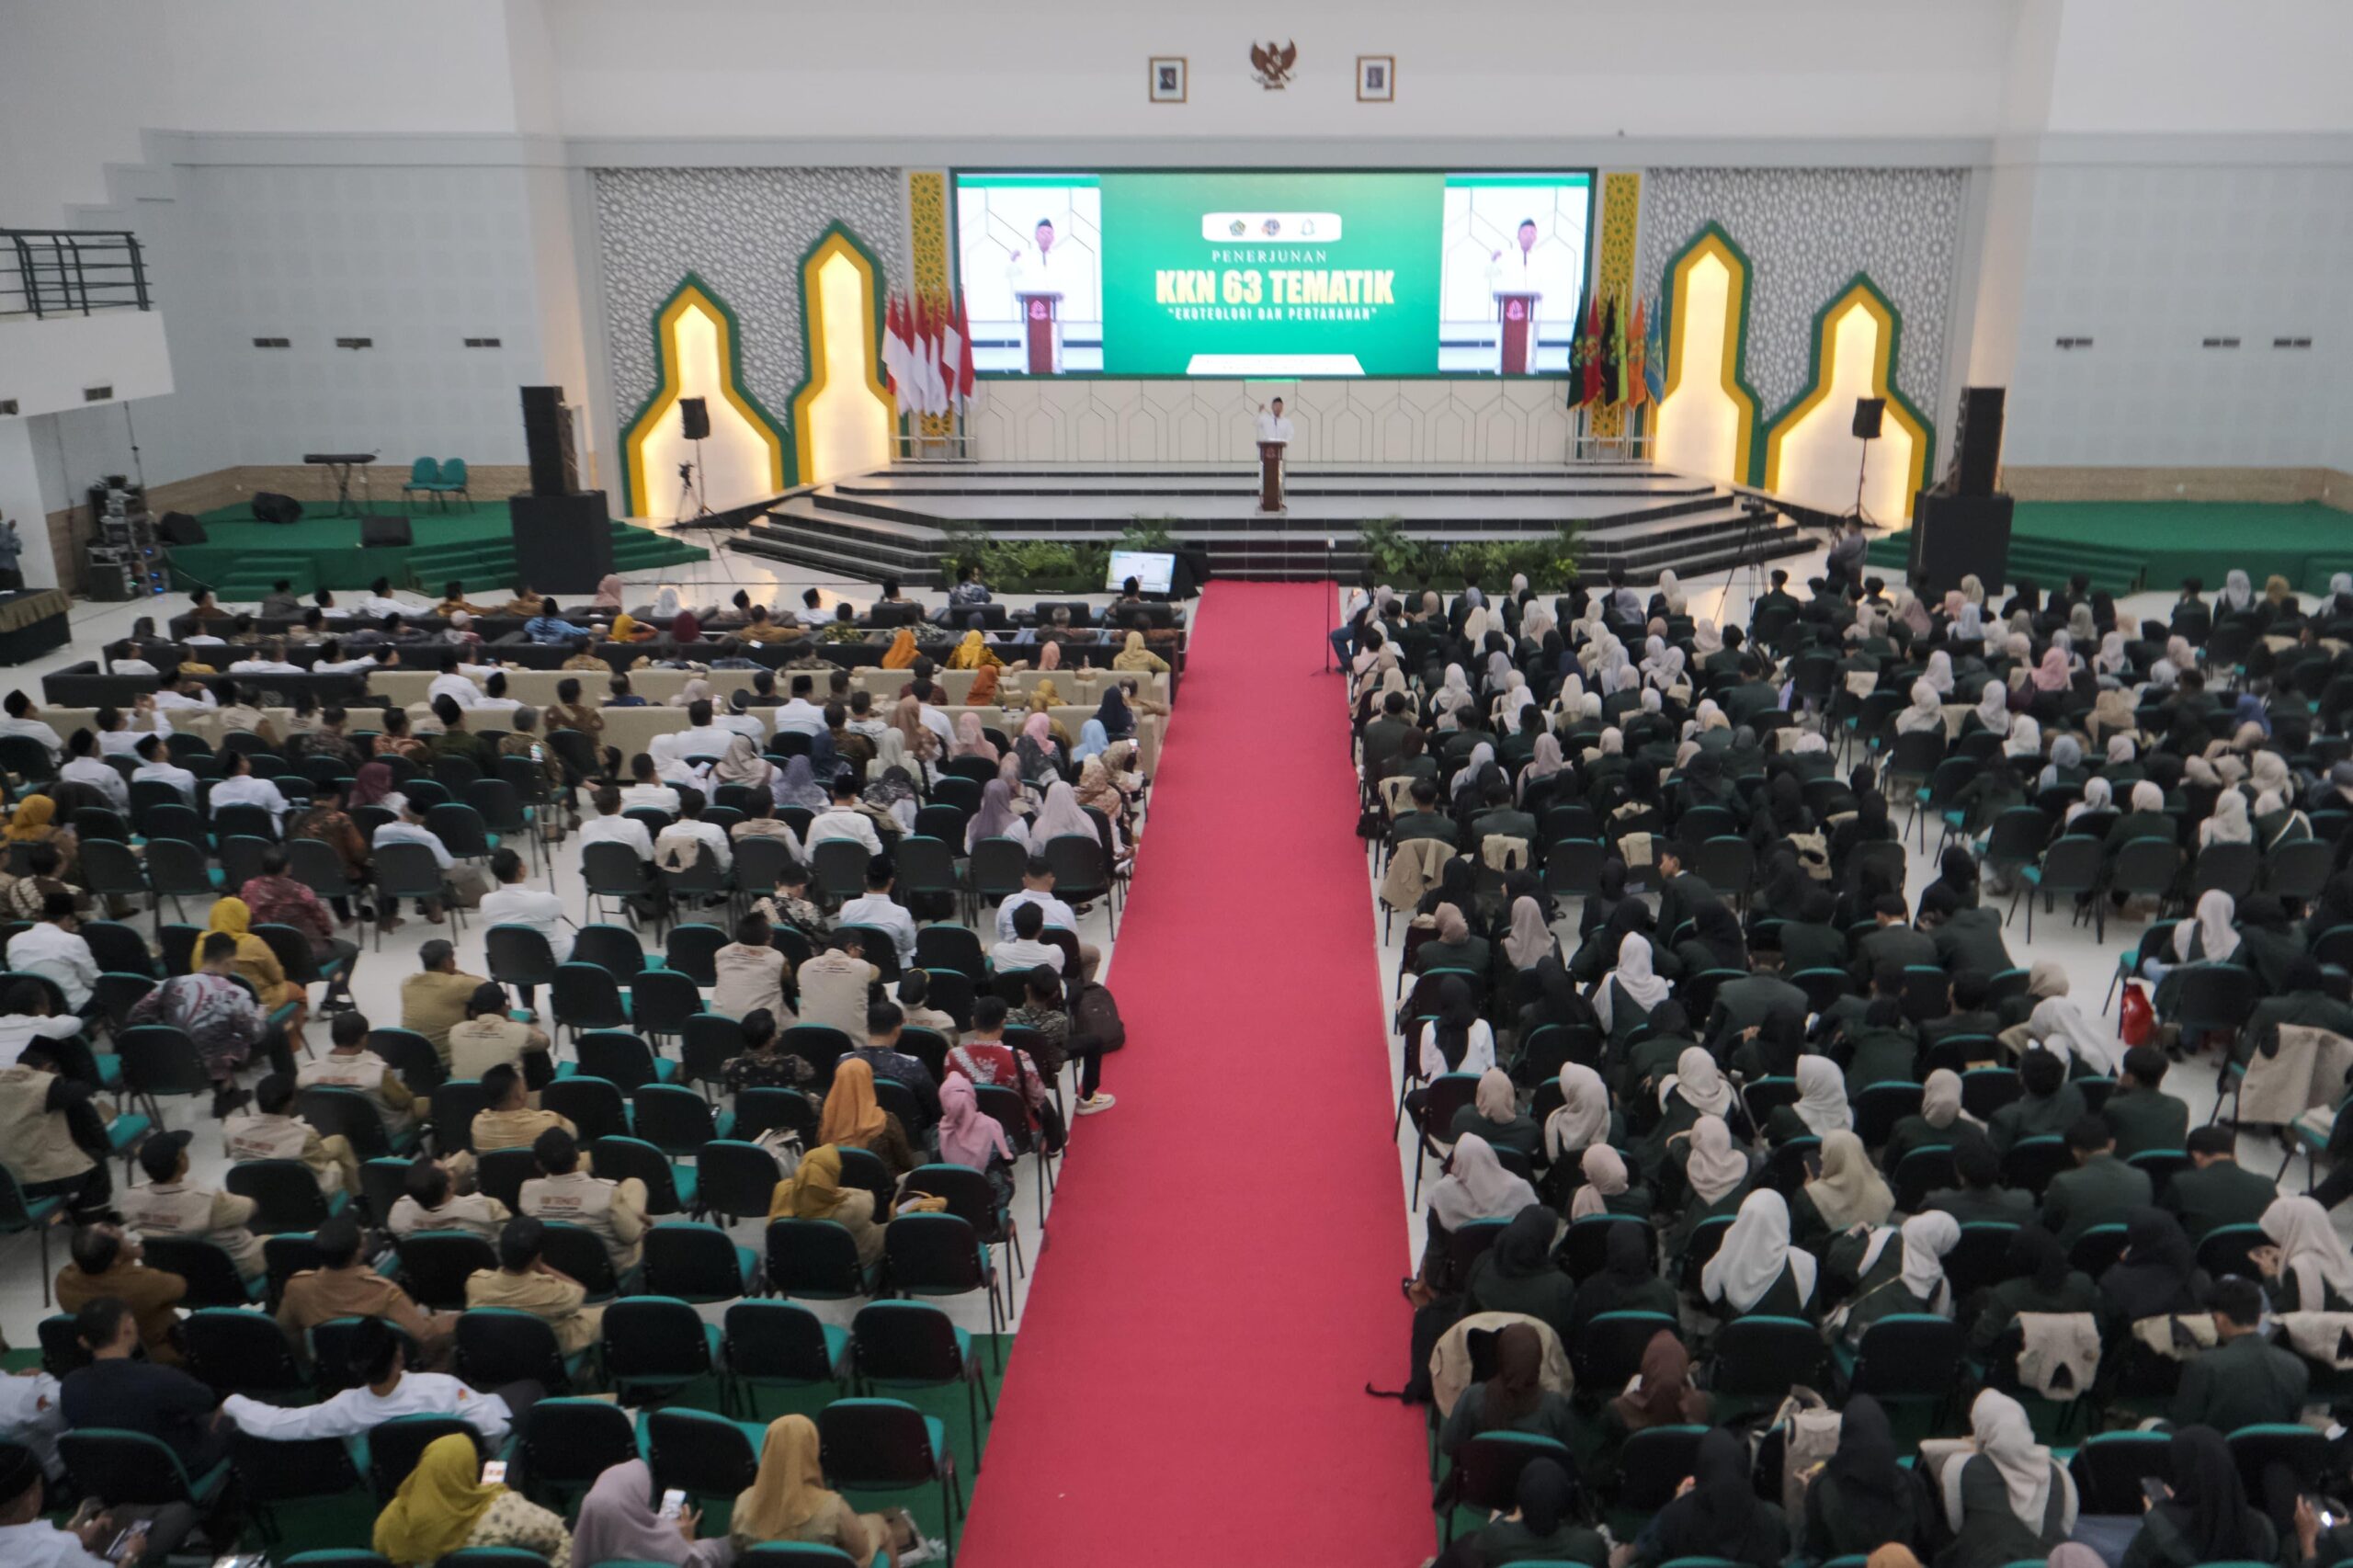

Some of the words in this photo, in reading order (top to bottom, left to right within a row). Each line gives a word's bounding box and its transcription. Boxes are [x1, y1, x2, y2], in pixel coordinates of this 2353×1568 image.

[1211, 249, 1328, 263] PENERJUNAN
[1155, 269, 1216, 304] KKN
[1222, 268, 1264, 304] 63
[1267, 269, 1395, 304] TEMATIK
[1257, 306, 1283, 321] DAN
